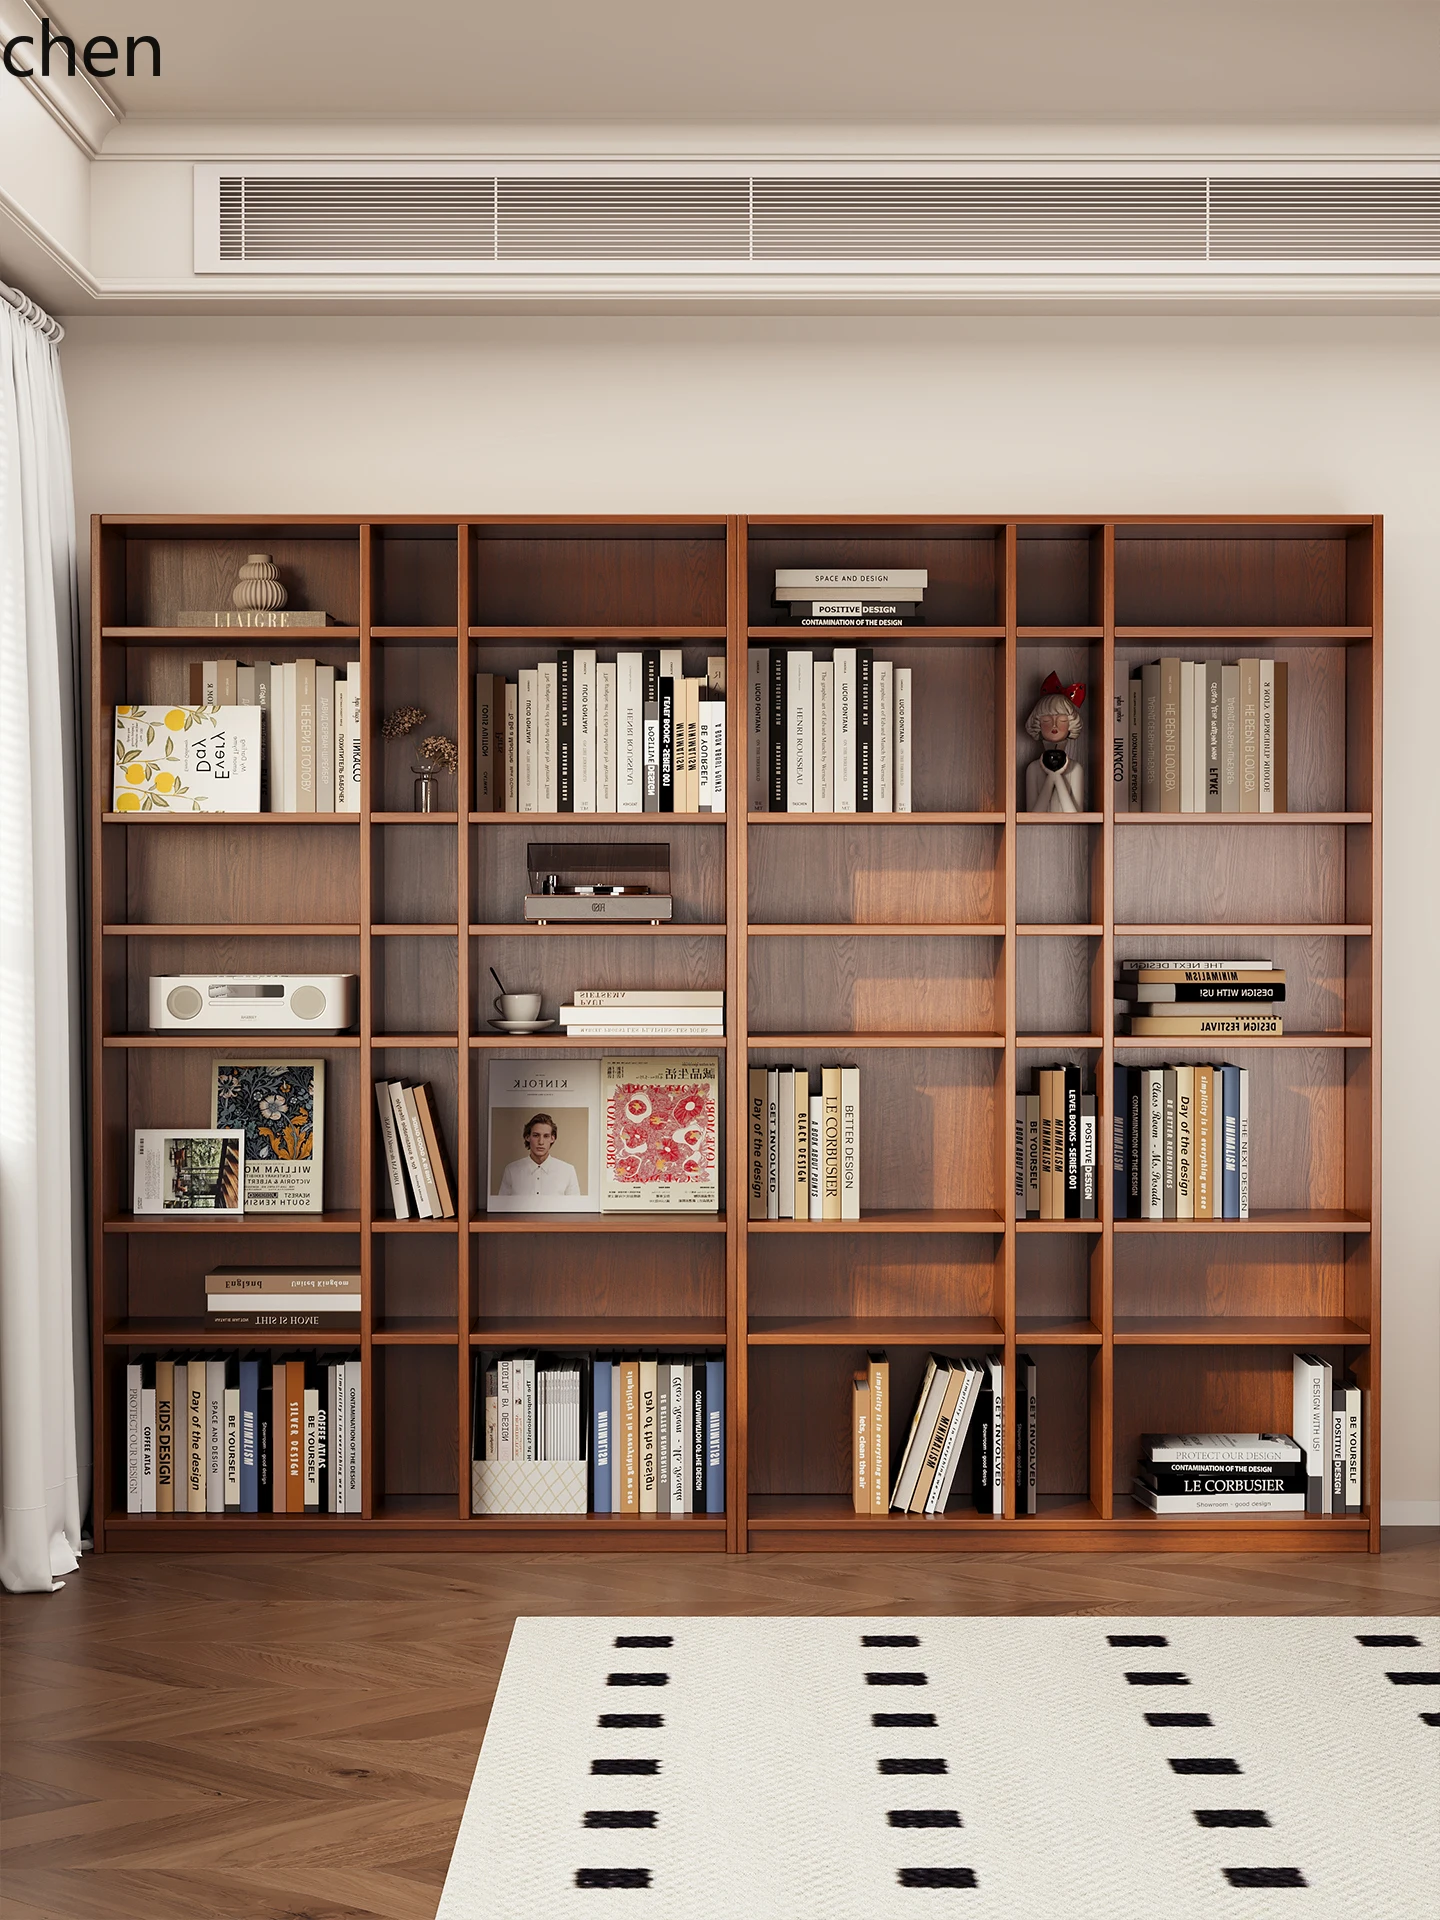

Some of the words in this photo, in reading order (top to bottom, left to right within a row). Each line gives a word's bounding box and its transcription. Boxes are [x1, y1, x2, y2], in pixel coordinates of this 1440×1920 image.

[214, 612, 289, 627] LIAIGRE
[300, 704, 312, 716] НЕ
[320, 697, 329, 722] ДАВИД
[300, 719, 312, 743] БЕРИ
[321, 721, 330, 785] СЕРВАН-ШРЕЙБЕР
[301, 754, 312, 793] ГОЛОВУ
[752, 1098, 763, 1120] Day
[826, 1096, 838, 1113] LE
[1152, 1082, 1161, 1107] Class
[1167, 1099, 1173, 1109] BE
[753, 1123, 763, 1136] of
[798, 1113, 807, 1143] BLACK
[845, 1105, 854, 1144] BETTER
[1151, 1110, 1161, 1138] Room
[754, 1138, 763, 1157] the
[825, 1117, 838, 1197] CORBUSIER
[1225, 1115, 1236, 1171] MINIMALISM
[797, 1148, 807, 1182] DESIGN
[845, 1147, 854, 1189] DESIGN
[1151, 1150, 1161, 1169] Ms.
[752, 1160, 763, 1198] design
[1151, 1171, 1161, 1206] Posada
[129, 1388, 138, 1433] PROTECT
[158, 1400, 171, 1432] KIDS
[290, 1402, 299, 1436] SILVER
[858, 1416, 866, 1434] lets,
[1349, 1416, 1357, 1429] BE
[129, 1434, 138, 1456] OUR
[243, 1410, 254, 1466] MINIMALISM
[1312, 1437, 1320, 1452] US!
[158, 1434, 171, 1485] DESIGN
[290, 1440, 299, 1476] DESIGN
[1171, 1464, 1225, 1472] CONTAMINATION
[1248, 1465, 1273, 1473] DESIGN
[1349, 1432, 1357, 1484] YOURSELF
[129, 1458, 138, 1494] DESIGN
[1184, 1480, 1201, 1492] LE
[1204, 1479, 1284, 1492] CORBUSIER
